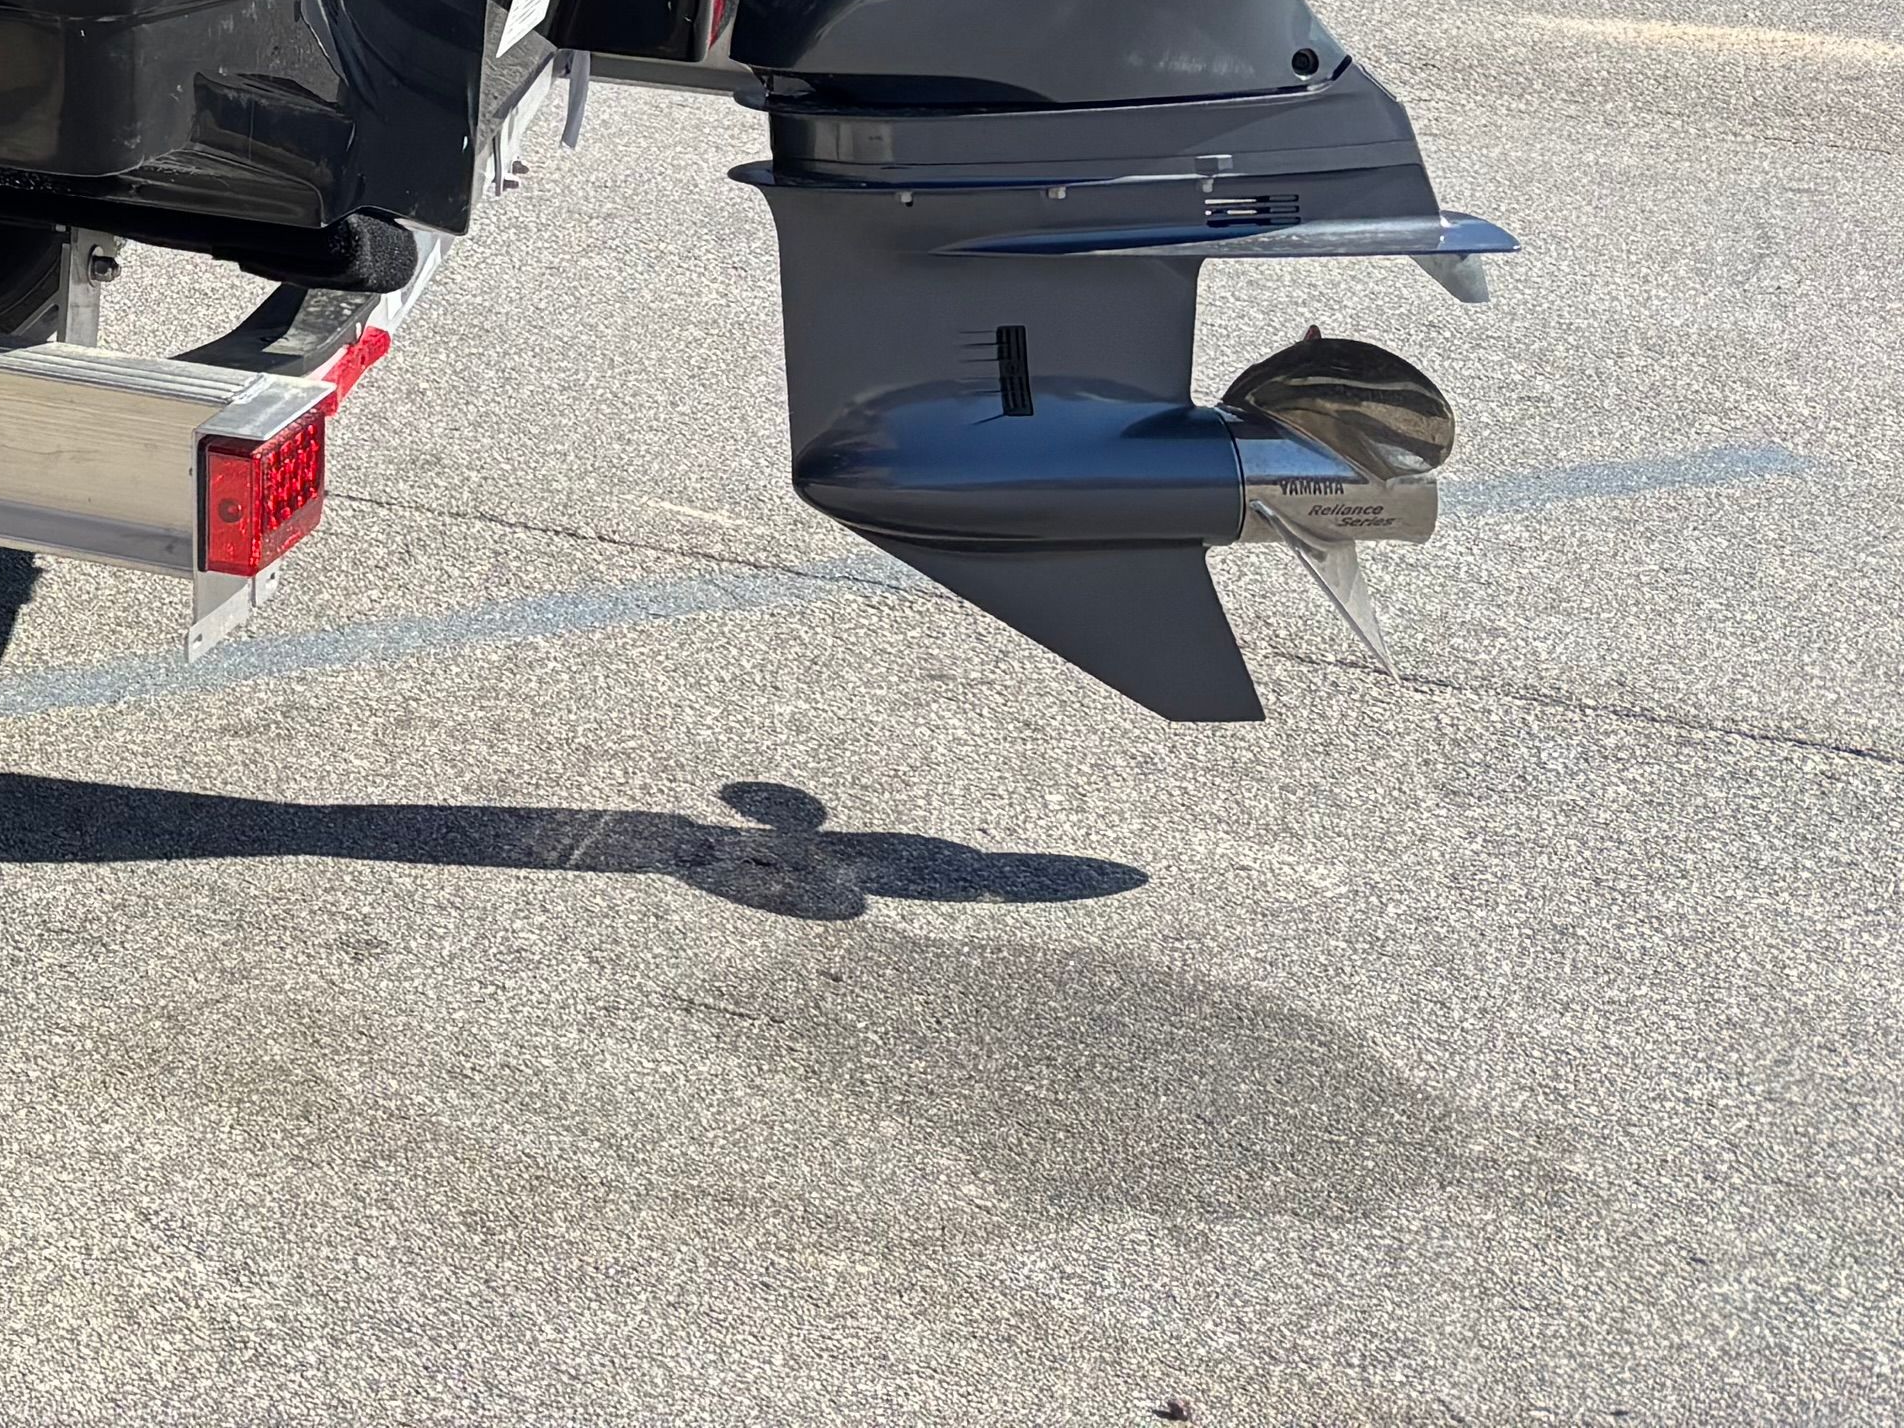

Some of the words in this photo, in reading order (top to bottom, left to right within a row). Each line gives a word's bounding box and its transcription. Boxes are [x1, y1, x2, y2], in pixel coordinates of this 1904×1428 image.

[1279, 478, 1345, 495] YAMAHA
[1307, 504, 1384, 517] Reliance
[1336, 516, 1398, 527] Series
